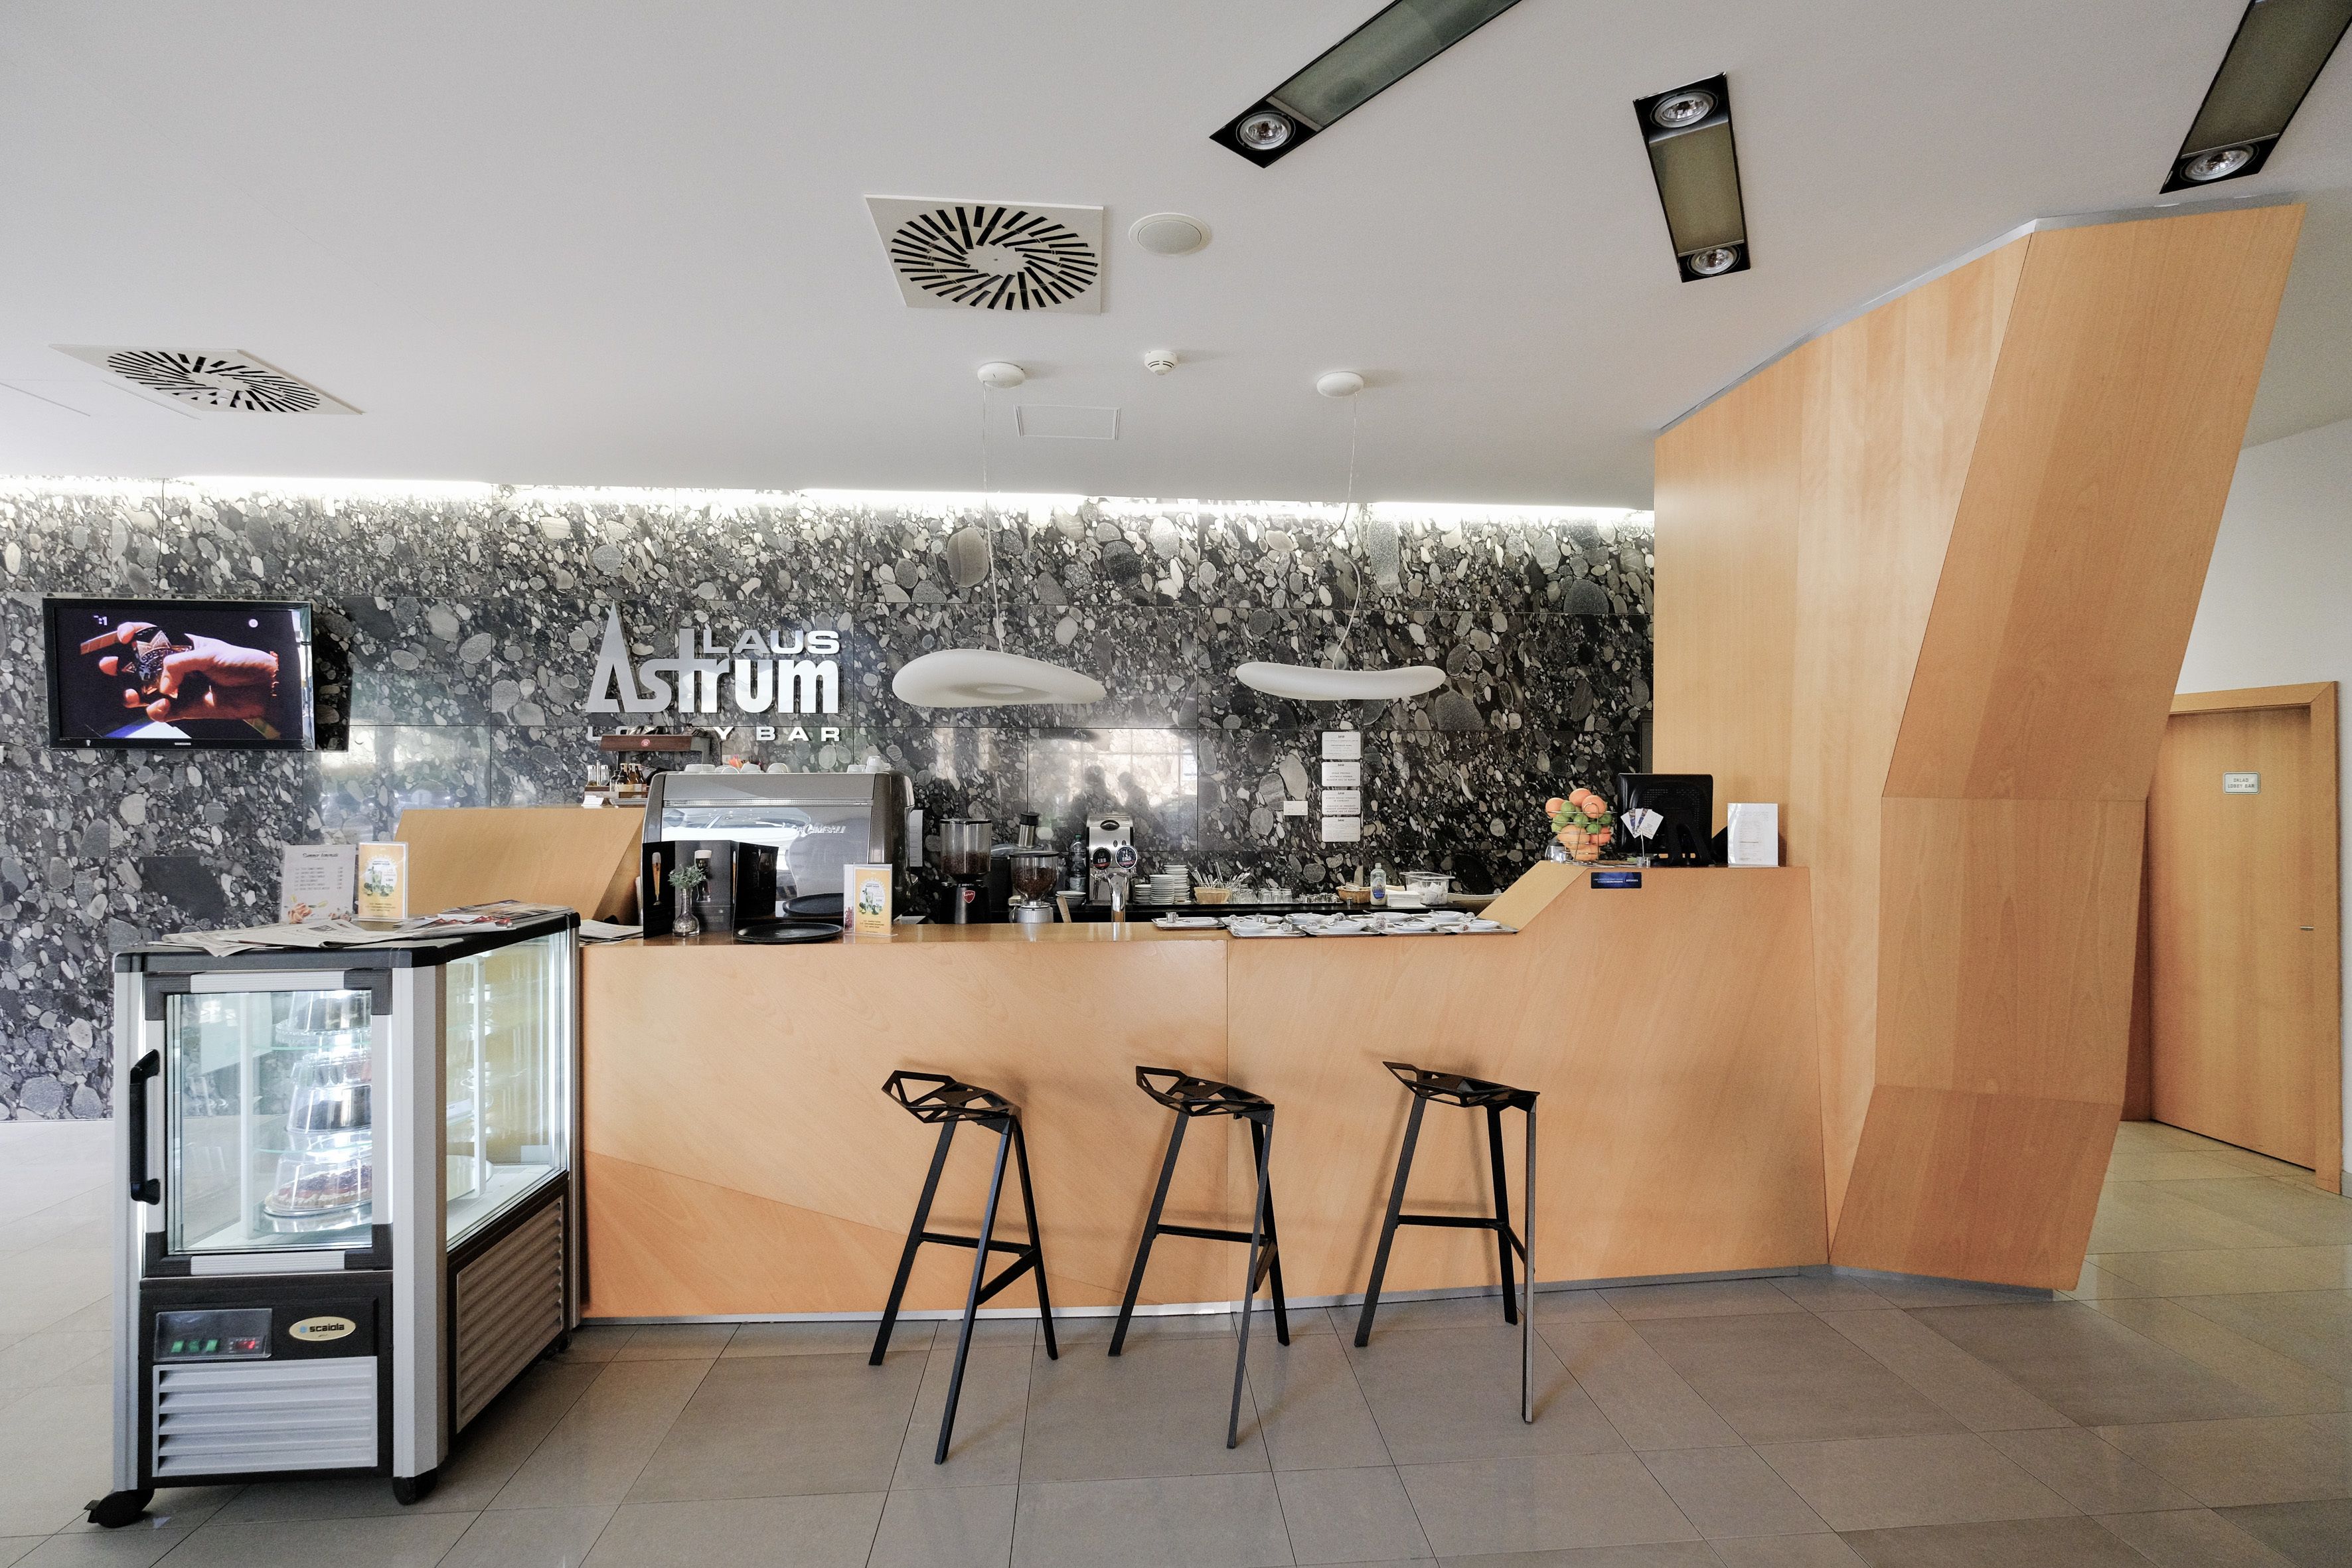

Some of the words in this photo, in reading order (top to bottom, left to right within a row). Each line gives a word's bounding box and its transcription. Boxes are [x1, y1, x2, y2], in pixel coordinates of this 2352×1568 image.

[703, 629, 840, 654] LAUS
[585, 598, 840, 714] Astrum
[756, 726, 840, 742] BAR
[309, 1323, 345, 1332] scaiola
